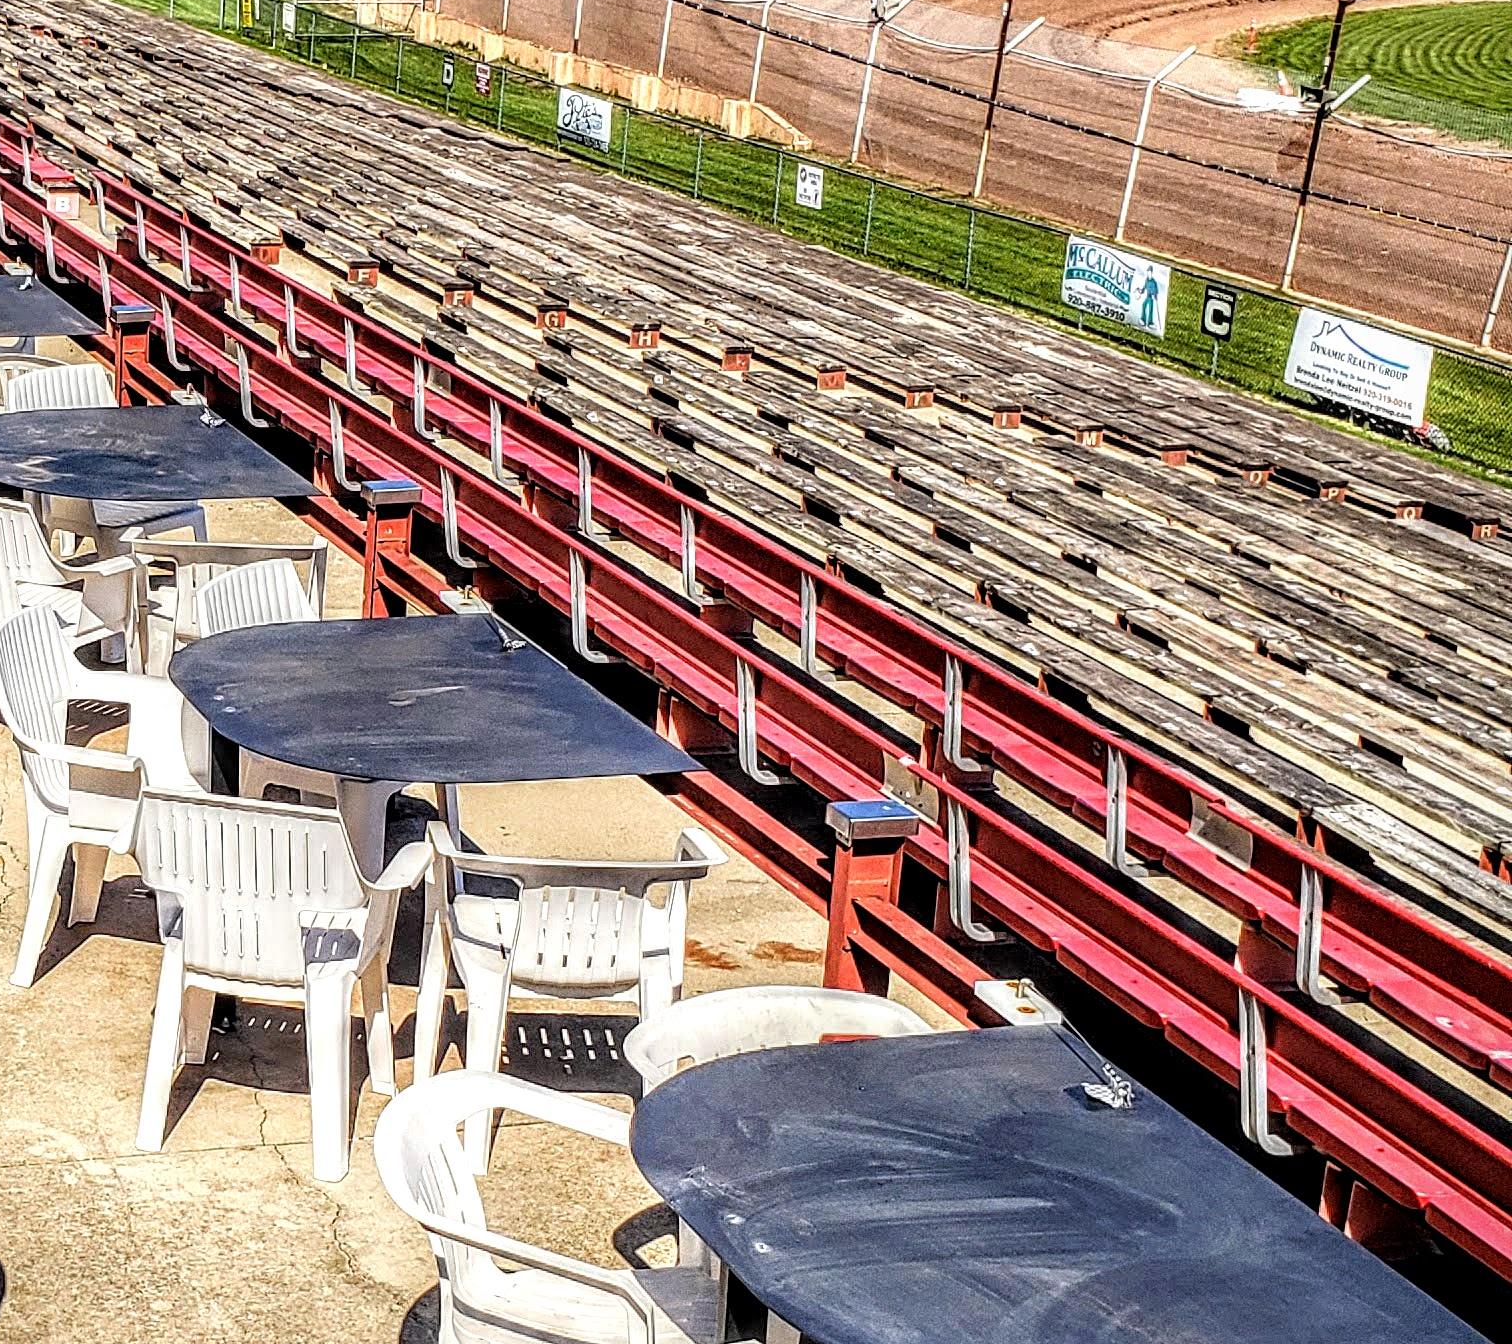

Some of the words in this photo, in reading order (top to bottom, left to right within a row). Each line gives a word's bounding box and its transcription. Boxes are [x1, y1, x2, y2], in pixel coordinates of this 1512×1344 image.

[56, 197, 71, 212] B
[544, 311, 559, 328] G
[1204, 298, 1232, 336] C
[639, 332, 652, 346] H
[1310, 341, 1345, 362] DYNAMIC
[1347, 353, 1377, 372] REALTY
[1379, 364, 1408, 382] GROUP
[1328, 487, 1339, 499] P
[1480, 524, 1492, 538] R
